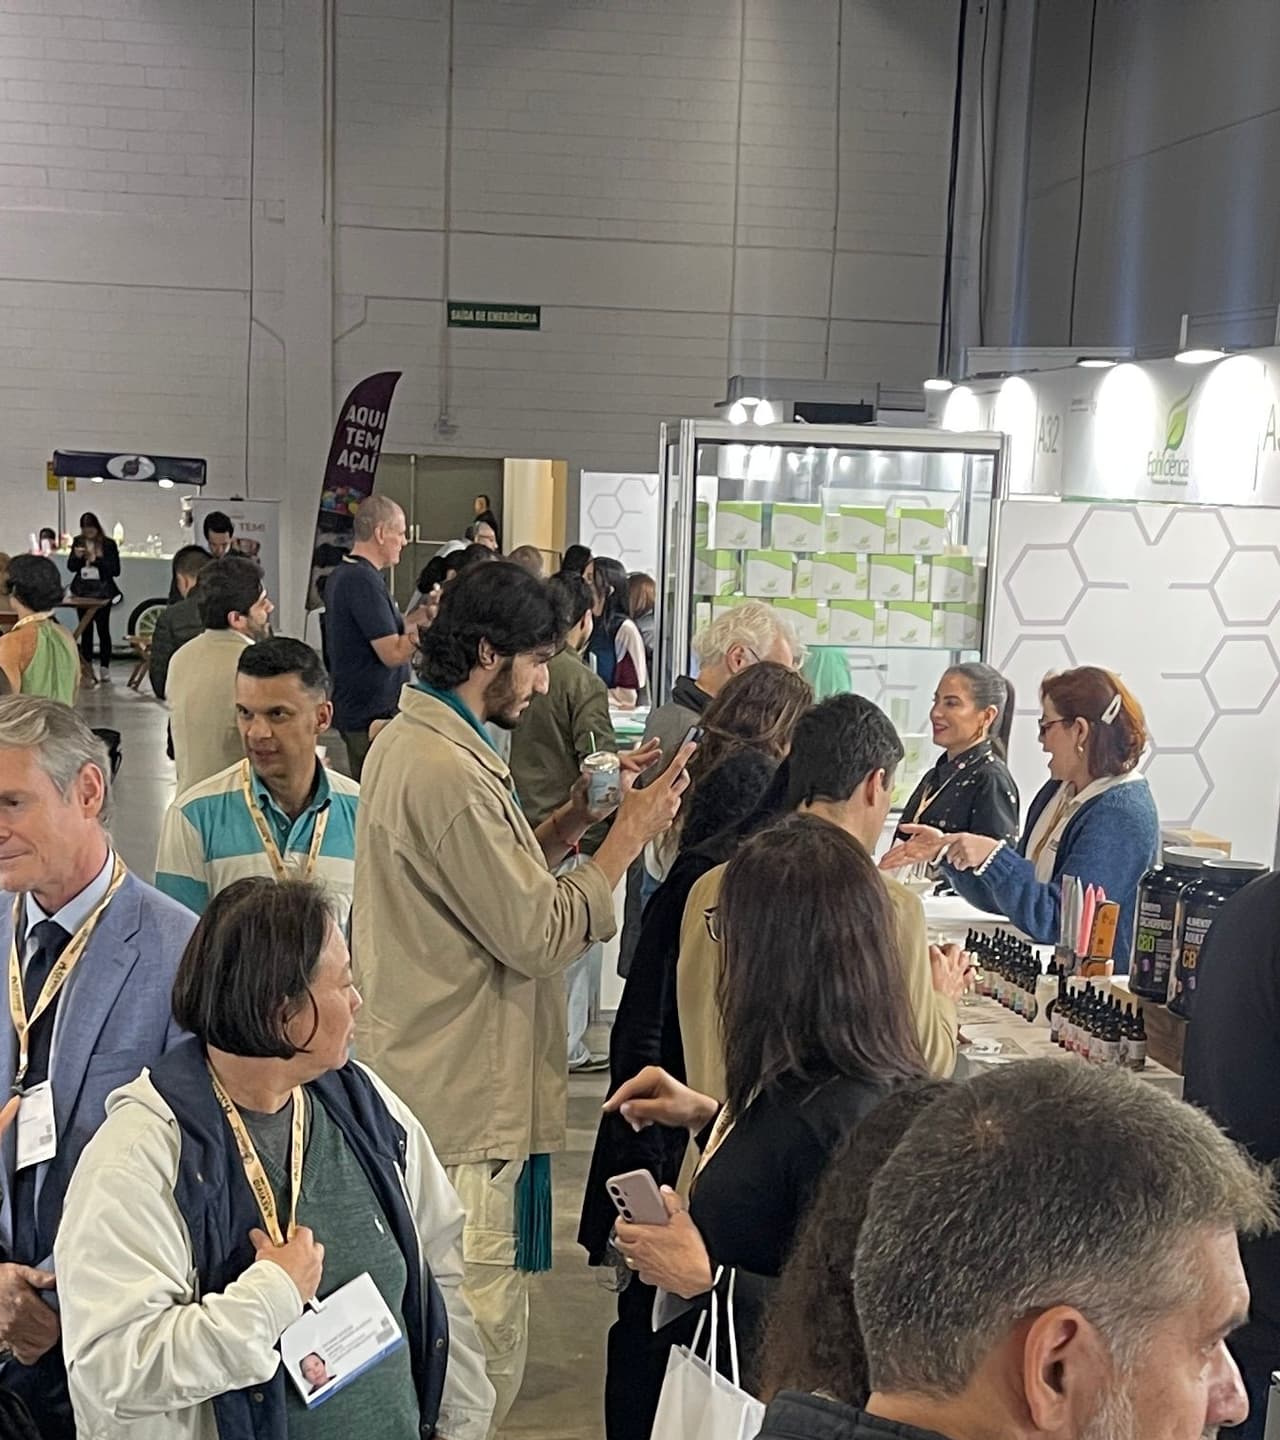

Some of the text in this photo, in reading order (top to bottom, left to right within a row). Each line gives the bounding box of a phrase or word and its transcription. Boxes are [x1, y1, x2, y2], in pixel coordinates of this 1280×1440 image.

[345, 404, 386, 430] AQUI
[346, 426, 381, 451] TEM
[1027, 416, 1060, 453] A32
[337, 448, 378, 473] AÇAÍ
[1182, 950, 1198, 968] CB
